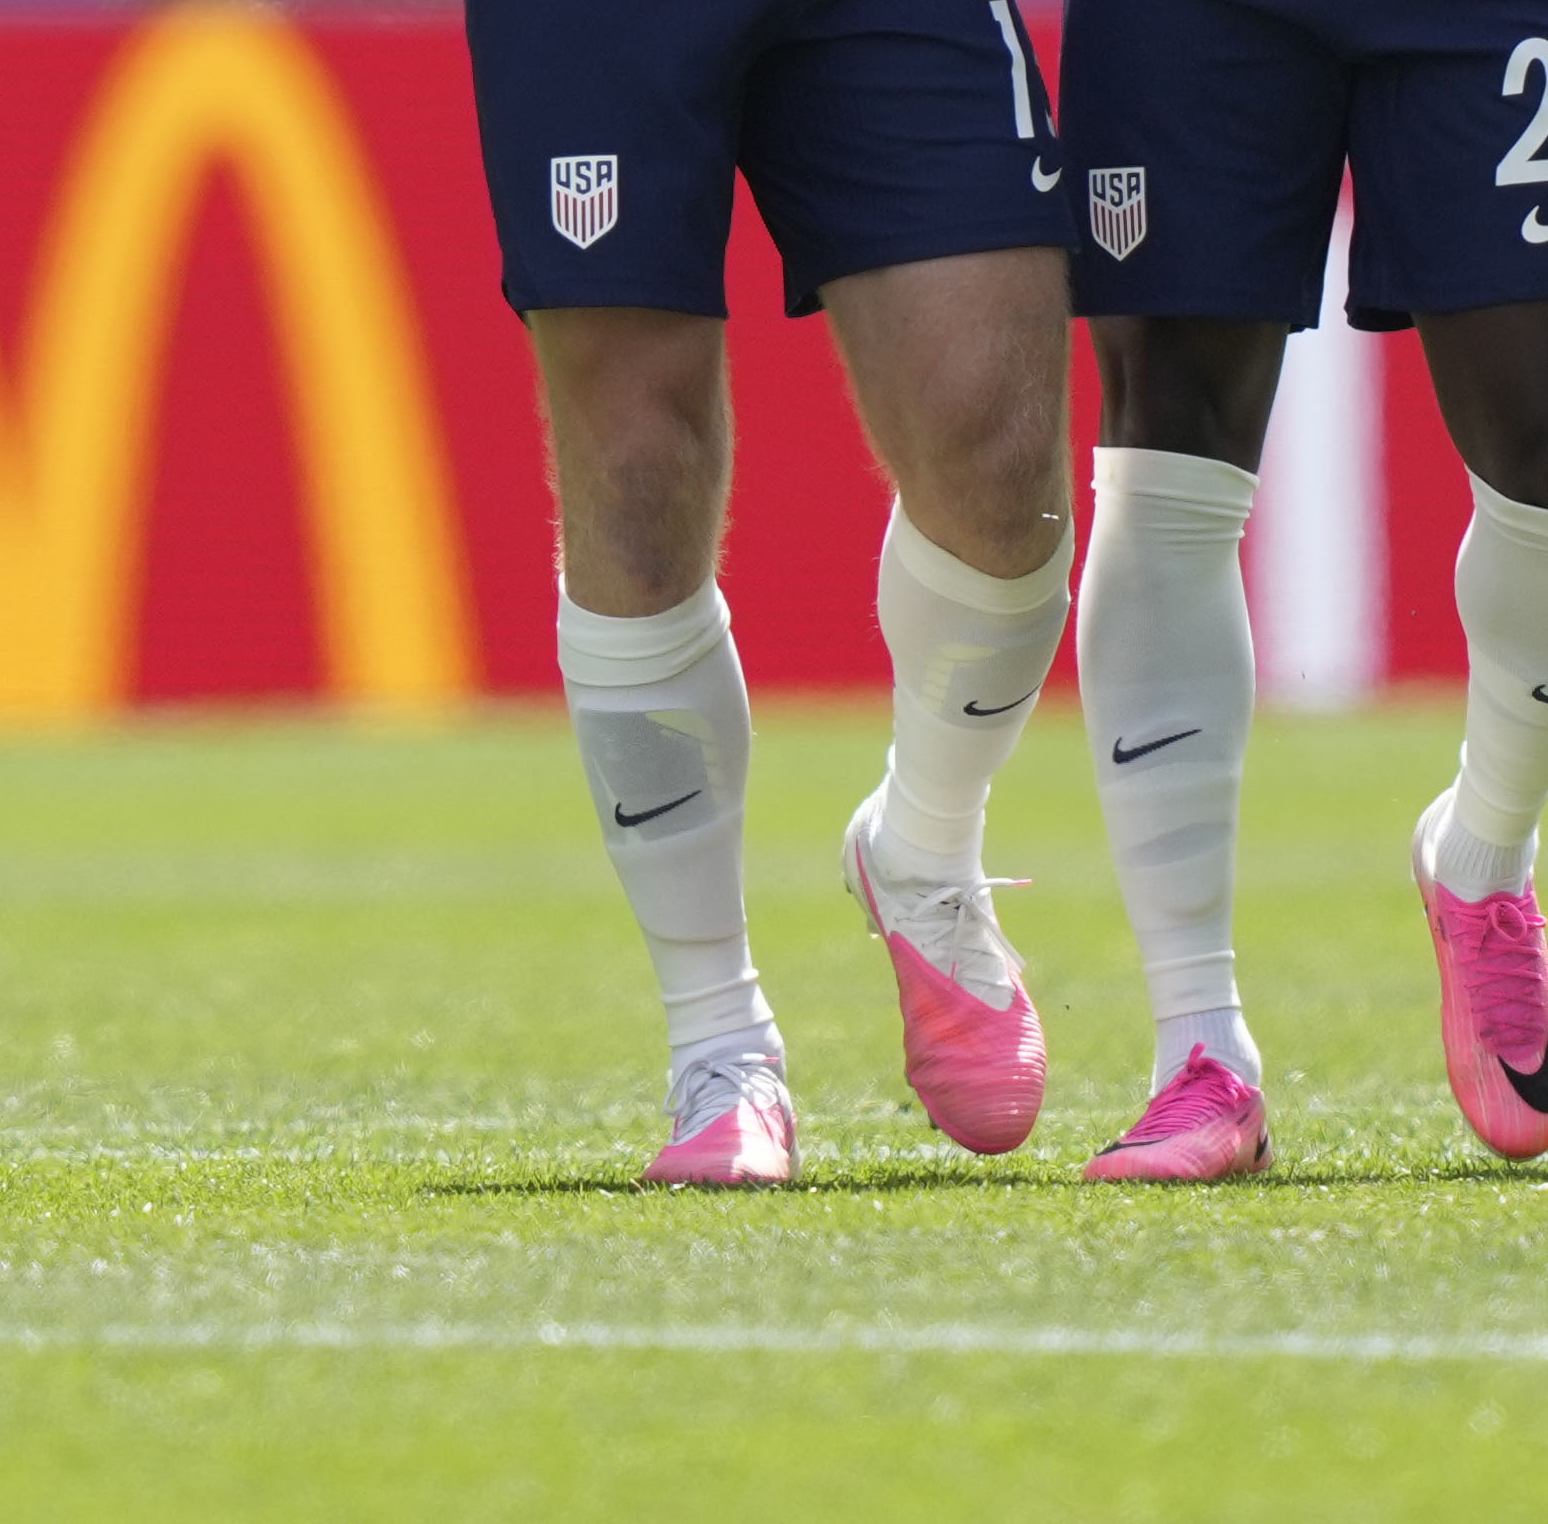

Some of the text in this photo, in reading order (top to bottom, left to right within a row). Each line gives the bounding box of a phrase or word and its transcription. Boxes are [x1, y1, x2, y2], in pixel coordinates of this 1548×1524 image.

[989, 0, 1056, 138] 1
[556, 160, 612, 195] USA
[1092, 172, 1140, 207] USA
